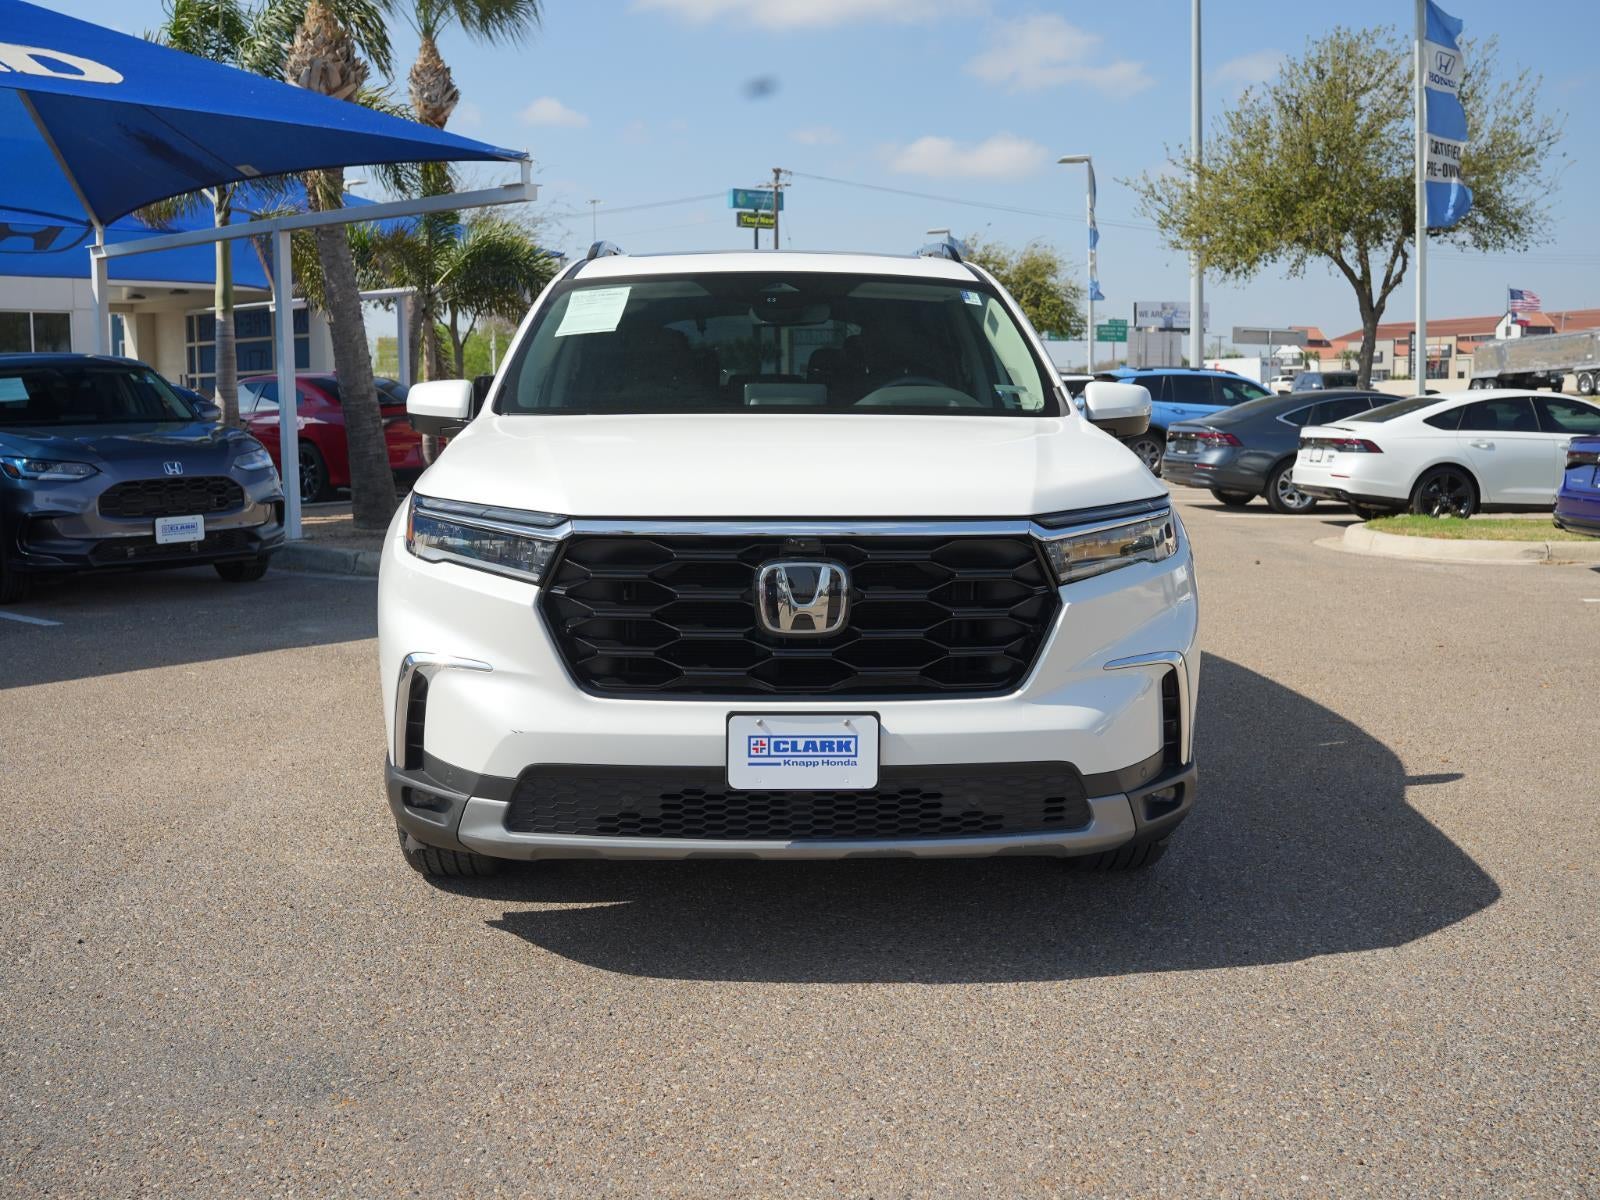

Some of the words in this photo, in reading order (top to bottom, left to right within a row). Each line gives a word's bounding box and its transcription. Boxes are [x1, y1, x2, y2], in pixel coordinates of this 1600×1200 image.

[773, 740, 852, 753] CLARK
[783, 759, 820, 768] Knapp
[821, 759, 857, 767] Honda
